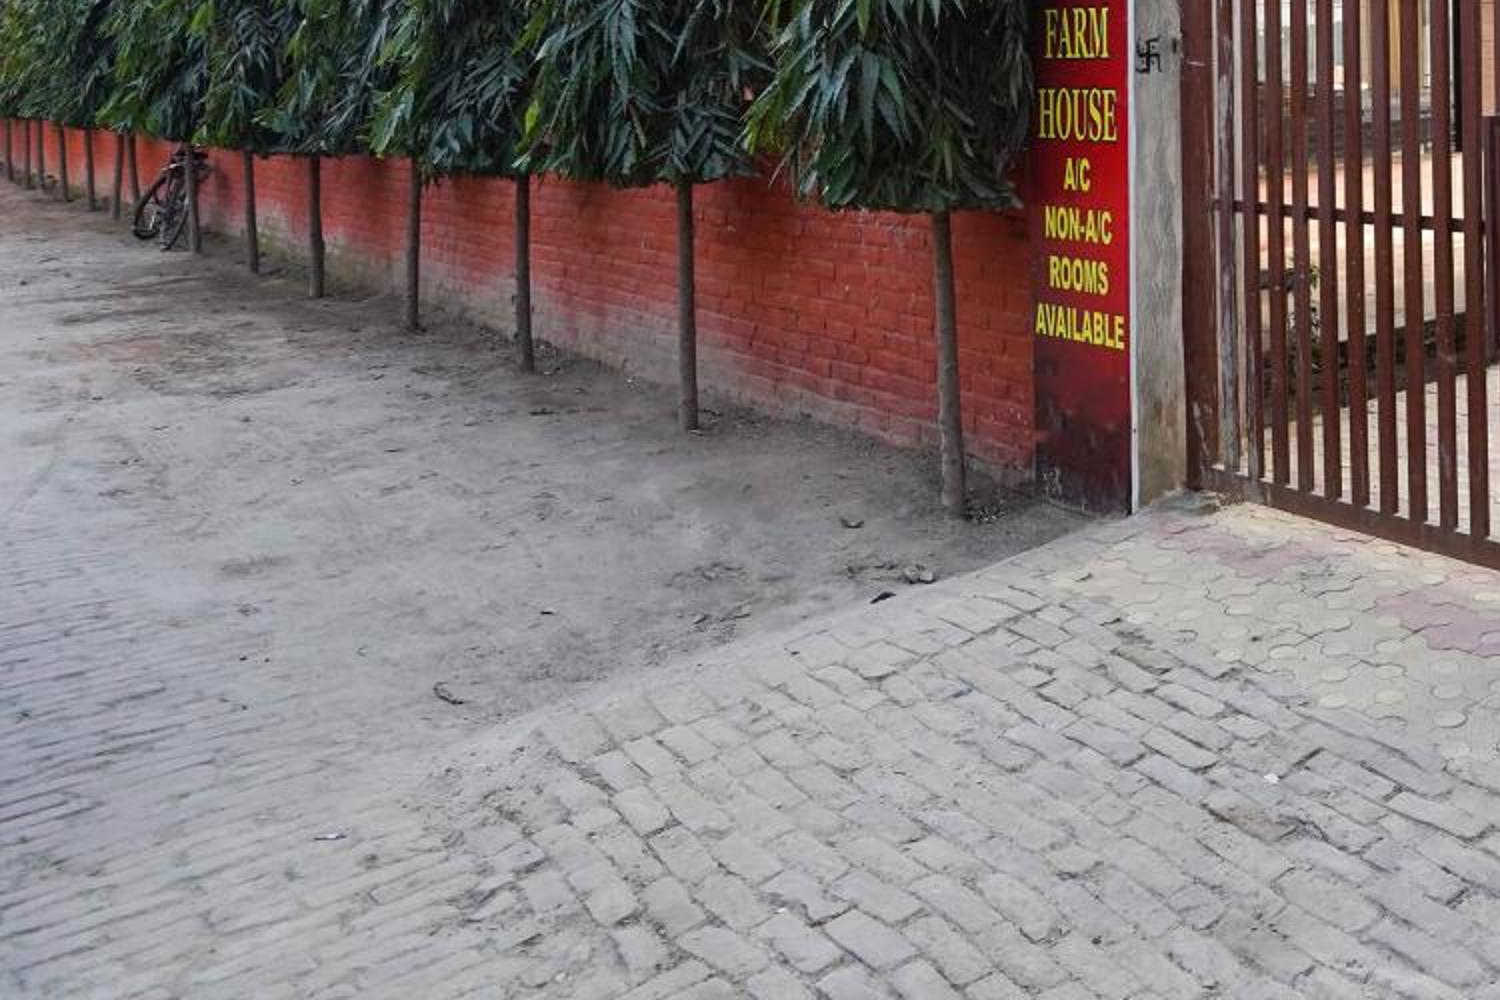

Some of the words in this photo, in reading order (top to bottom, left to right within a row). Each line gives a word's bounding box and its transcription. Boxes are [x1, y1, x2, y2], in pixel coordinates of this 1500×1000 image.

[1044, 7, 1110, 59] FARM
[1038, 88, 1117, 142] HOUSE
[1063, 157, 1091, 192] A/C
[1045, 205, 1113, 246] NON-A/C
[1049, 255, 1109, 295] ROOMS
[1035, 303, 1125, 350] AVAILABLE
